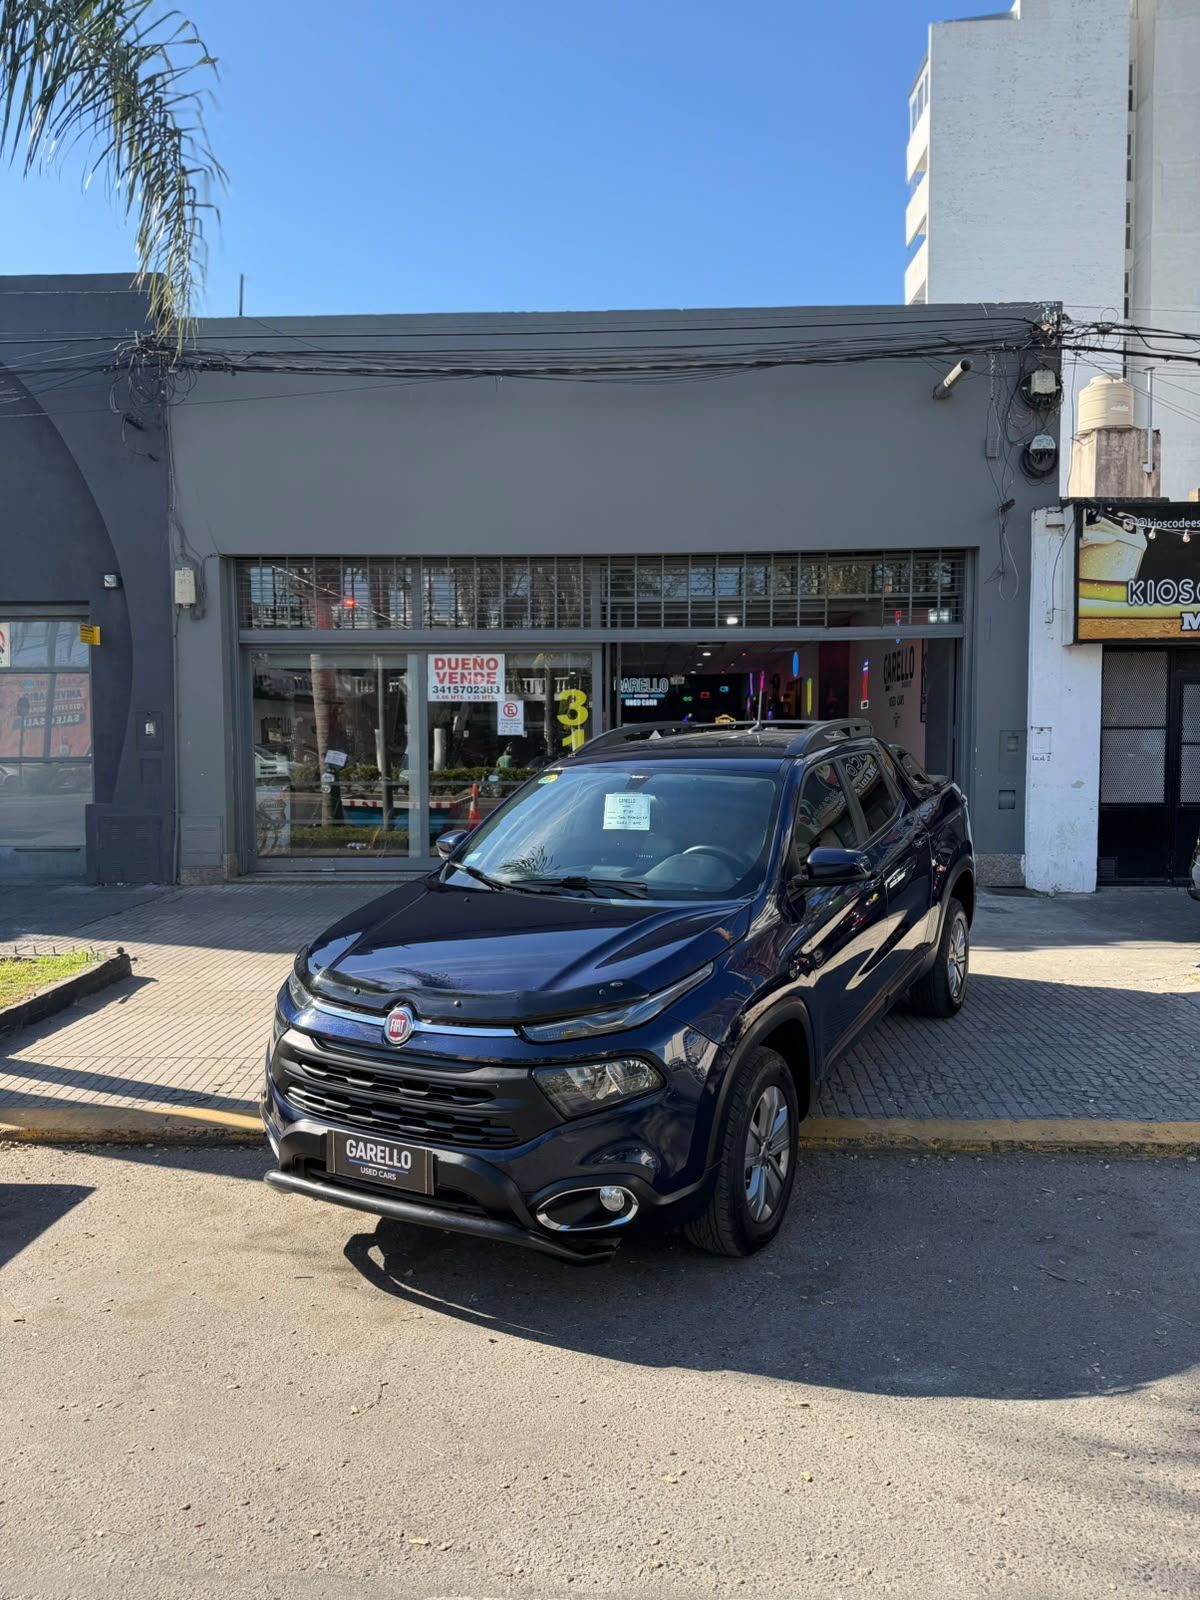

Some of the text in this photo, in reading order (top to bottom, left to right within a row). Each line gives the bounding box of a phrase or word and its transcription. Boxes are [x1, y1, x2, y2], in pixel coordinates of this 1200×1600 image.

[1128, 578, 1200, 605] KIOS
[434, 655, 499, 671] DUEÑO
[436, 671, 497, 685] VENDE
[432, 685, 500, 694] 3415702383
[390, 1018, 406, 1033] FIAT
[346, 1139, 412, 1170] GARELLO
[360, 1166, 396, 1181] USED CARS
